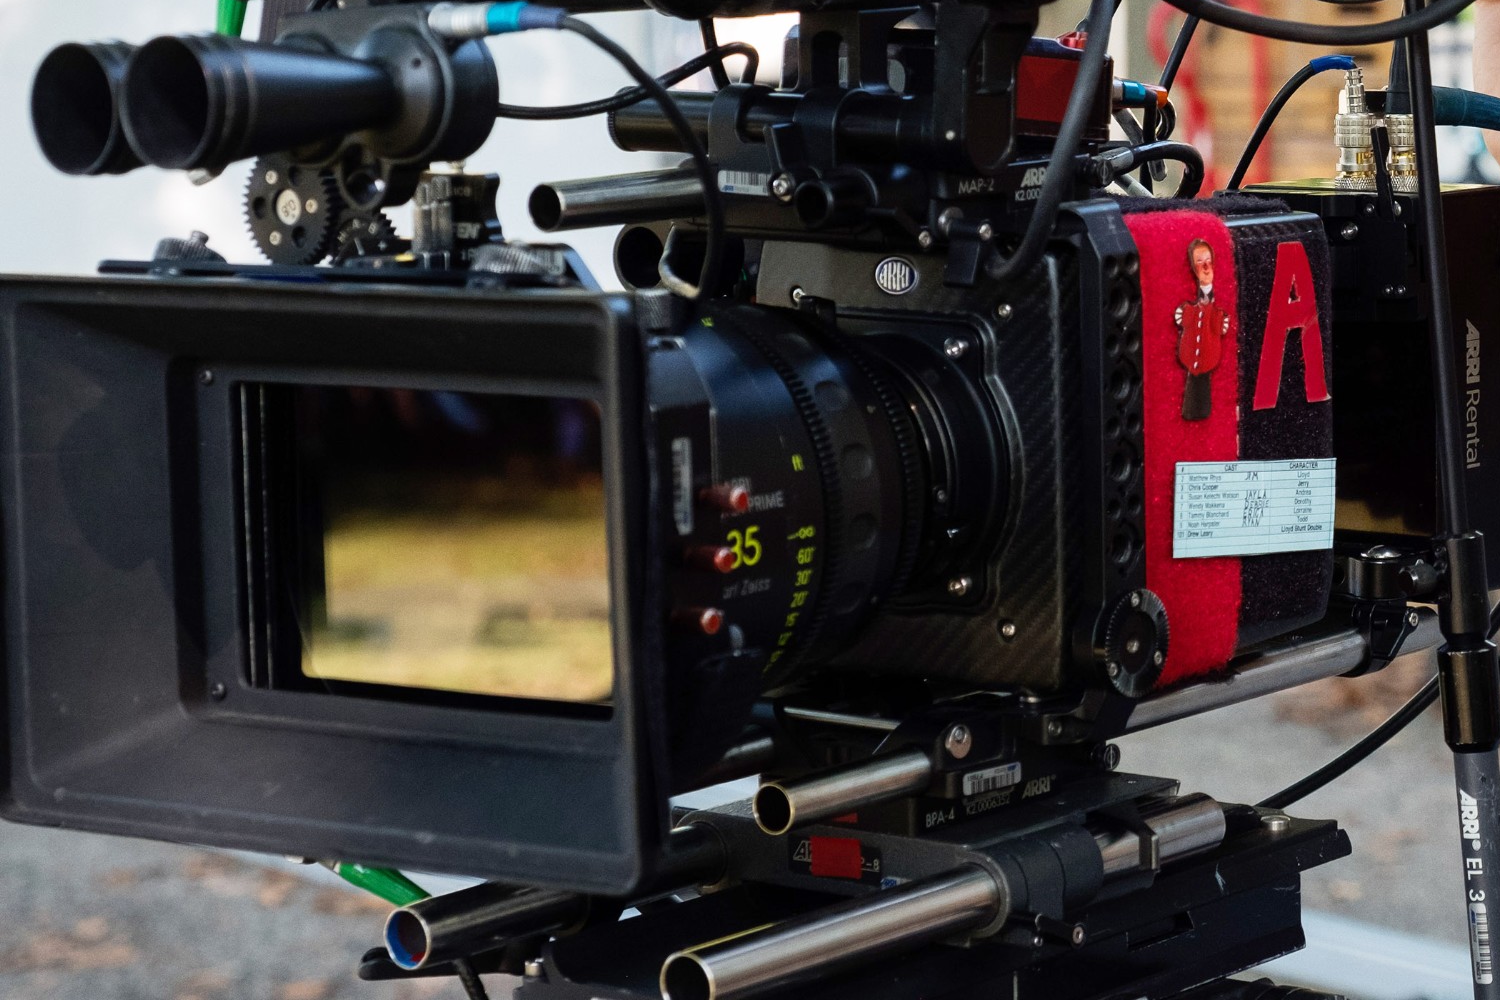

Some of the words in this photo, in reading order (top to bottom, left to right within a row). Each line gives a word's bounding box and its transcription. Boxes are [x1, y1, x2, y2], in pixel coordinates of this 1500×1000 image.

[958, 178, 995, 194] MAP-2
[1020, 167, 1047, 188] ARR
[1252, 241, 1331, 412] A
[1466, 318, 1481, 385] ARRI
[1466, 388, 1481, 470] Rental
[1224, 464, 1238, 473] CAST
[1289, 461, 1318, 470] CHARACTER
[1297, 471, 1311, 479] Lloyd
[1189, 474, 1209, 482] Matthew
[1202, 484, 1219, 492] Cooper
[1297, 480, 1310, 488] Jerry
[1187, 530, 1199, 538] Drew
[1200, 530, 1213, 538] Leary
[1281, 525, 1294, 533] Lloyd
[1307, 524, 1322, 532] Double
[727, 525, 761, 570] 35
[1022, 774, 1052, 799] ARRI
[925, 807, 955, 829] BPA-4
[1460, 788, 1480, 840] ARRI
[1466, 858, 1484, 881] EL
